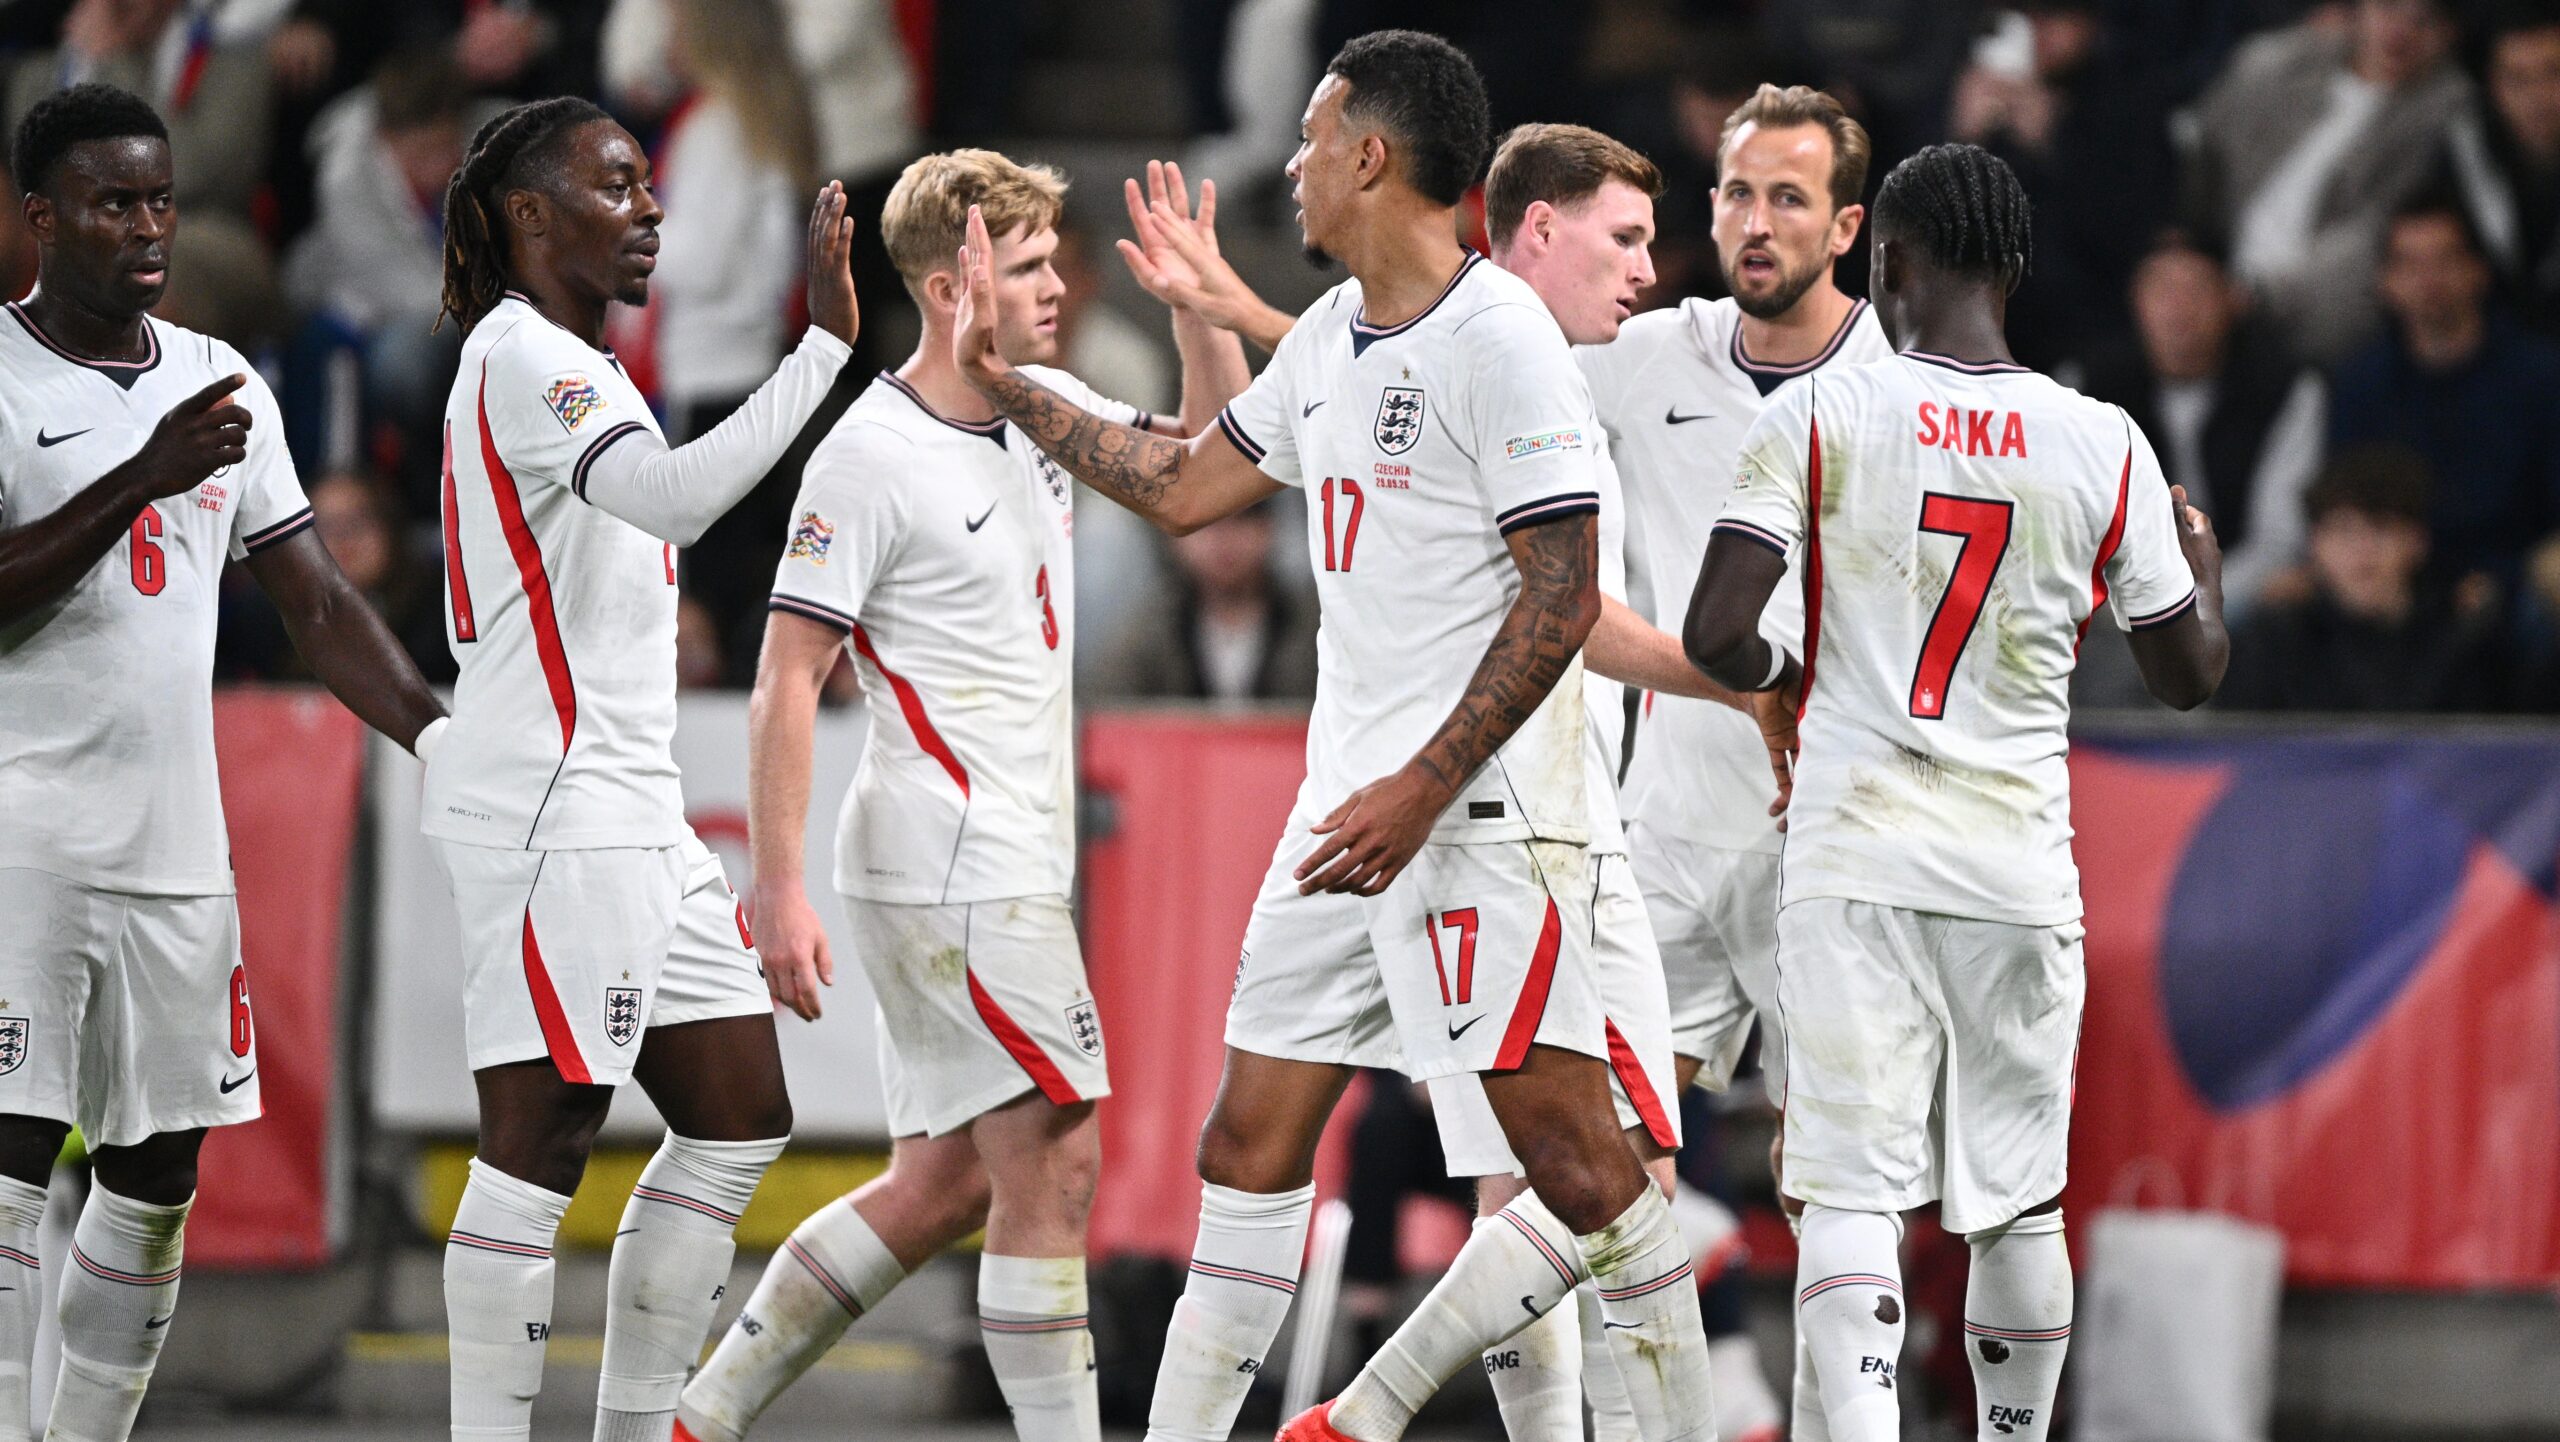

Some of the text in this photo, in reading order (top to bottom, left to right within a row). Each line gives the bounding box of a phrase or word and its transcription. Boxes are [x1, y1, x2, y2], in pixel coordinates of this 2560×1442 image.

[1507, 432, 1582, 455] FOUNDATION
[1917, 401, 2027, 458] SAKA
[1374, 463, 1411, 476] CZECHIA
[130, 503, 166, 597] 6
[1321, 477, 1365, 572] 17
[1036, 563, 1059, 651] 3
[1909, 491, 2014, 720] 7
[447, 806, 493, 821] AERO-FIT
[1426, 907, 1479, 1006] 17
[230, 965, 252, 1057] 6
[1485, 1351, 1520, 1374] ENG
[1989, 1405, 2034, 1425] ENG
